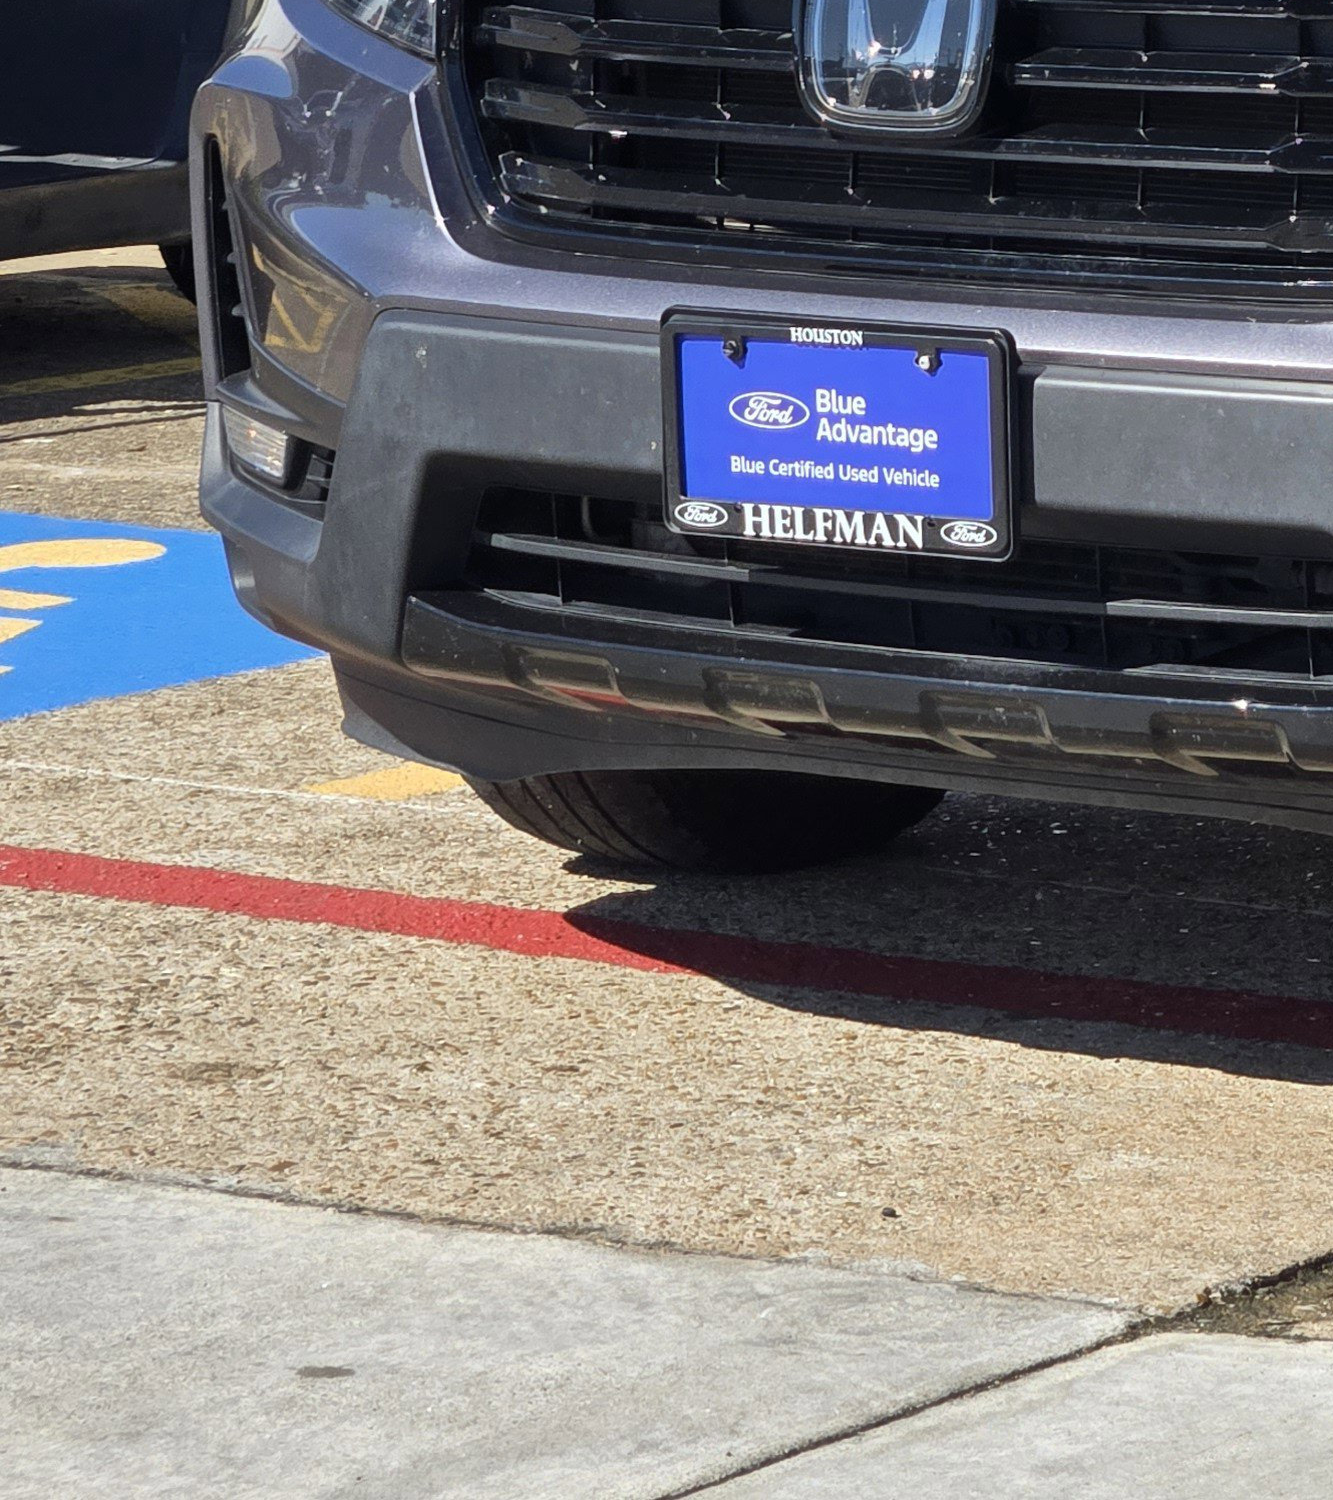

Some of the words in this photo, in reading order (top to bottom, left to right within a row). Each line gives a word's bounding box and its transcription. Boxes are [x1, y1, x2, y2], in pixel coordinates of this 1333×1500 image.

[789, 326, 863, 346] HOUSTON
[743, 395, 794, 424] Ford
[815, 388, 866, 415] Blue
[816, 417, 938, 452] Advantage
[730, 455, 765, 474] Blue
[768, 458, 834, 480] Certified
[838, 462, 879, 483] Used
[882, 466, 940, 488] Vehicle
[742, 502, 924, 549] HELFMAN
